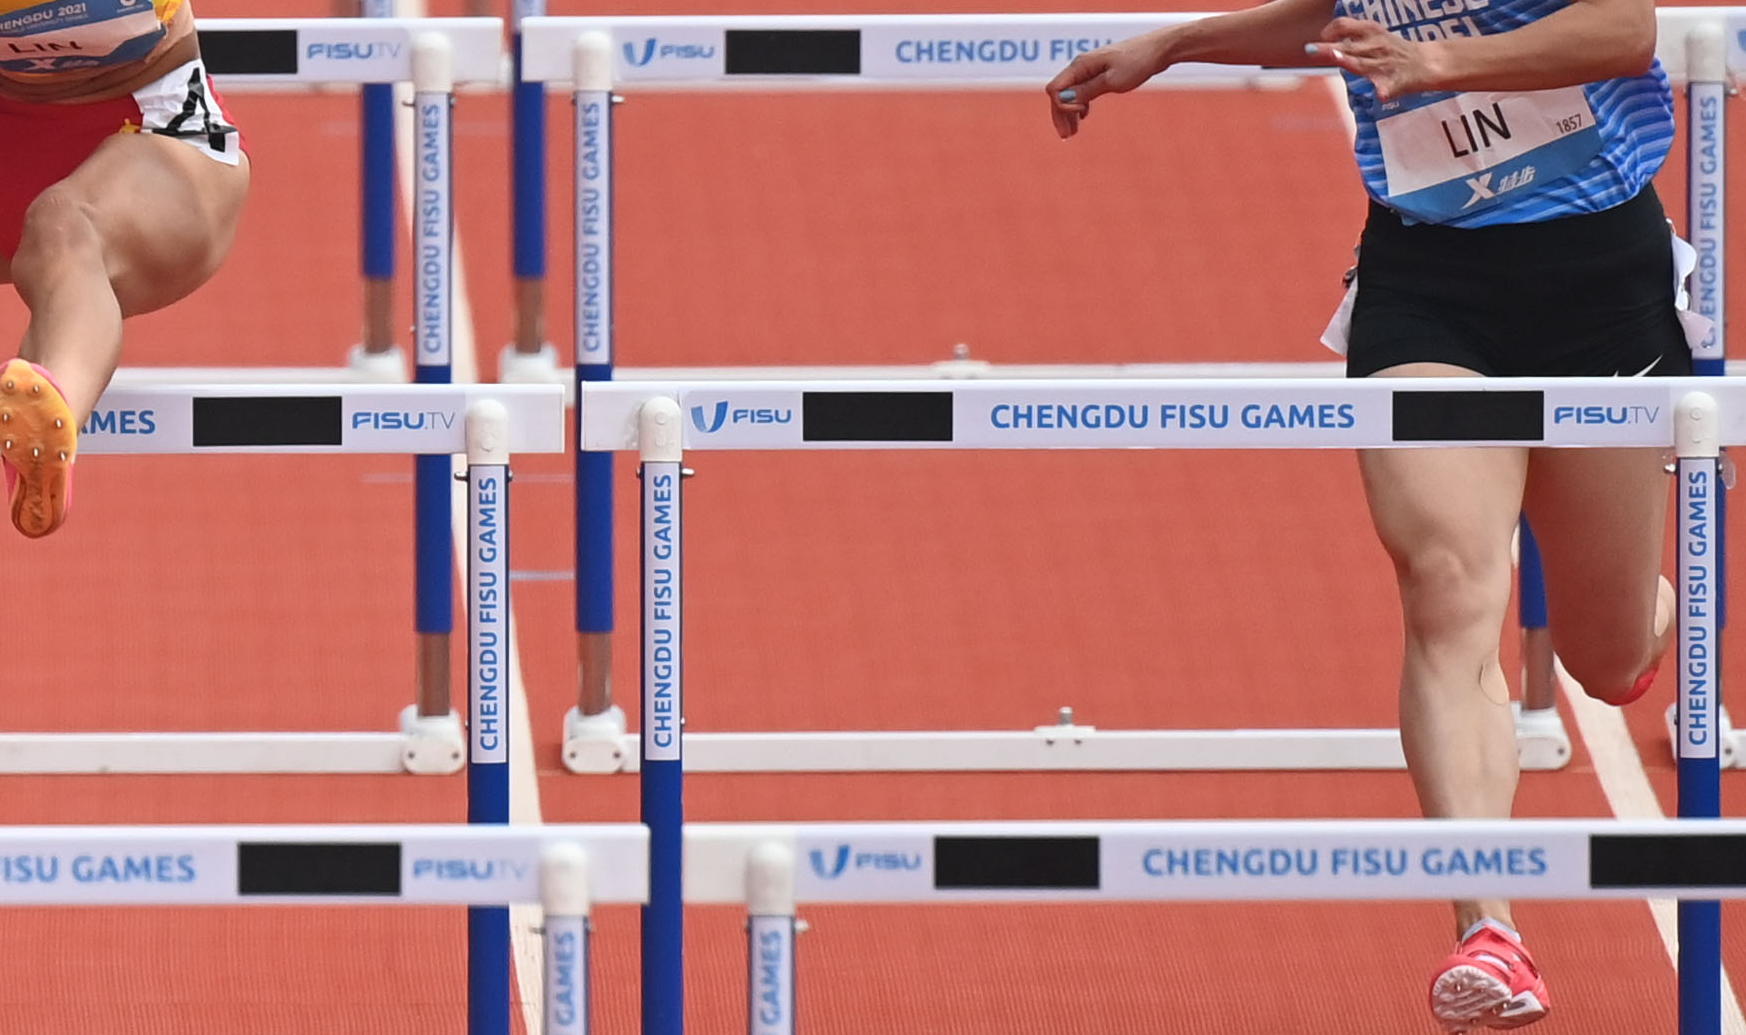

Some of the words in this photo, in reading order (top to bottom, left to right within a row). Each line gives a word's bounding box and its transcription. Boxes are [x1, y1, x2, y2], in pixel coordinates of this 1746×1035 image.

[57, 2, 87, 16] 2021
[7, 39, 83, 54] LIN
[659, 44, 715, 59] FISU
[895, 39, 1041, 64] CHENGDU
[422, 104, 441, 182] GAMES
[582, 102, 600, 180] GAMES
[1441, 102, 1512, 159] LIN
[1556, 113, 1583, 135] 1857
[1699, 96, 1717, 174] GAMES
[422, 189, 441, 238] FISU
[582, 188, 600, 236] FISU
[1699, 182, 1717, 231] FISU
[422, 245, 441, 354] CHENGDU
[582, 242, 600, 352] CHENGDU
[733, 408, 793, 425] FISU
[990, 403, 1151, 430] CHENGDU
[1161, 403, 1231, 429] FISU
[1242, 402, 1357, 429] GAMES
[477, 476, 498, 564] GAMES
[653, 474, 673, 561] GAMES
[1688, 470, 1708, 557] GAMES
[477, 571, 498, 624] FISU
[653, 568, 673, 621] FISU
[1688, 565, 1708, 618] FISU
[477, 631, 498, 751] CHENGDU
[653, 628, 673, 749] CHENGDU
[1688, 626, 1708, 746] CHENGDU
[72, 854, 198, 884] GAMES
[856, 853, 923, 870] FISU
[1143, 848, 1320, 877] CHENGDU
[1332, 848, 1410, 877] FISU
[1421, 847, 1550, 877] GAMES
[554, 931, 575, 1026] GAMES
[759, 930, 781, 1025] GAMES
